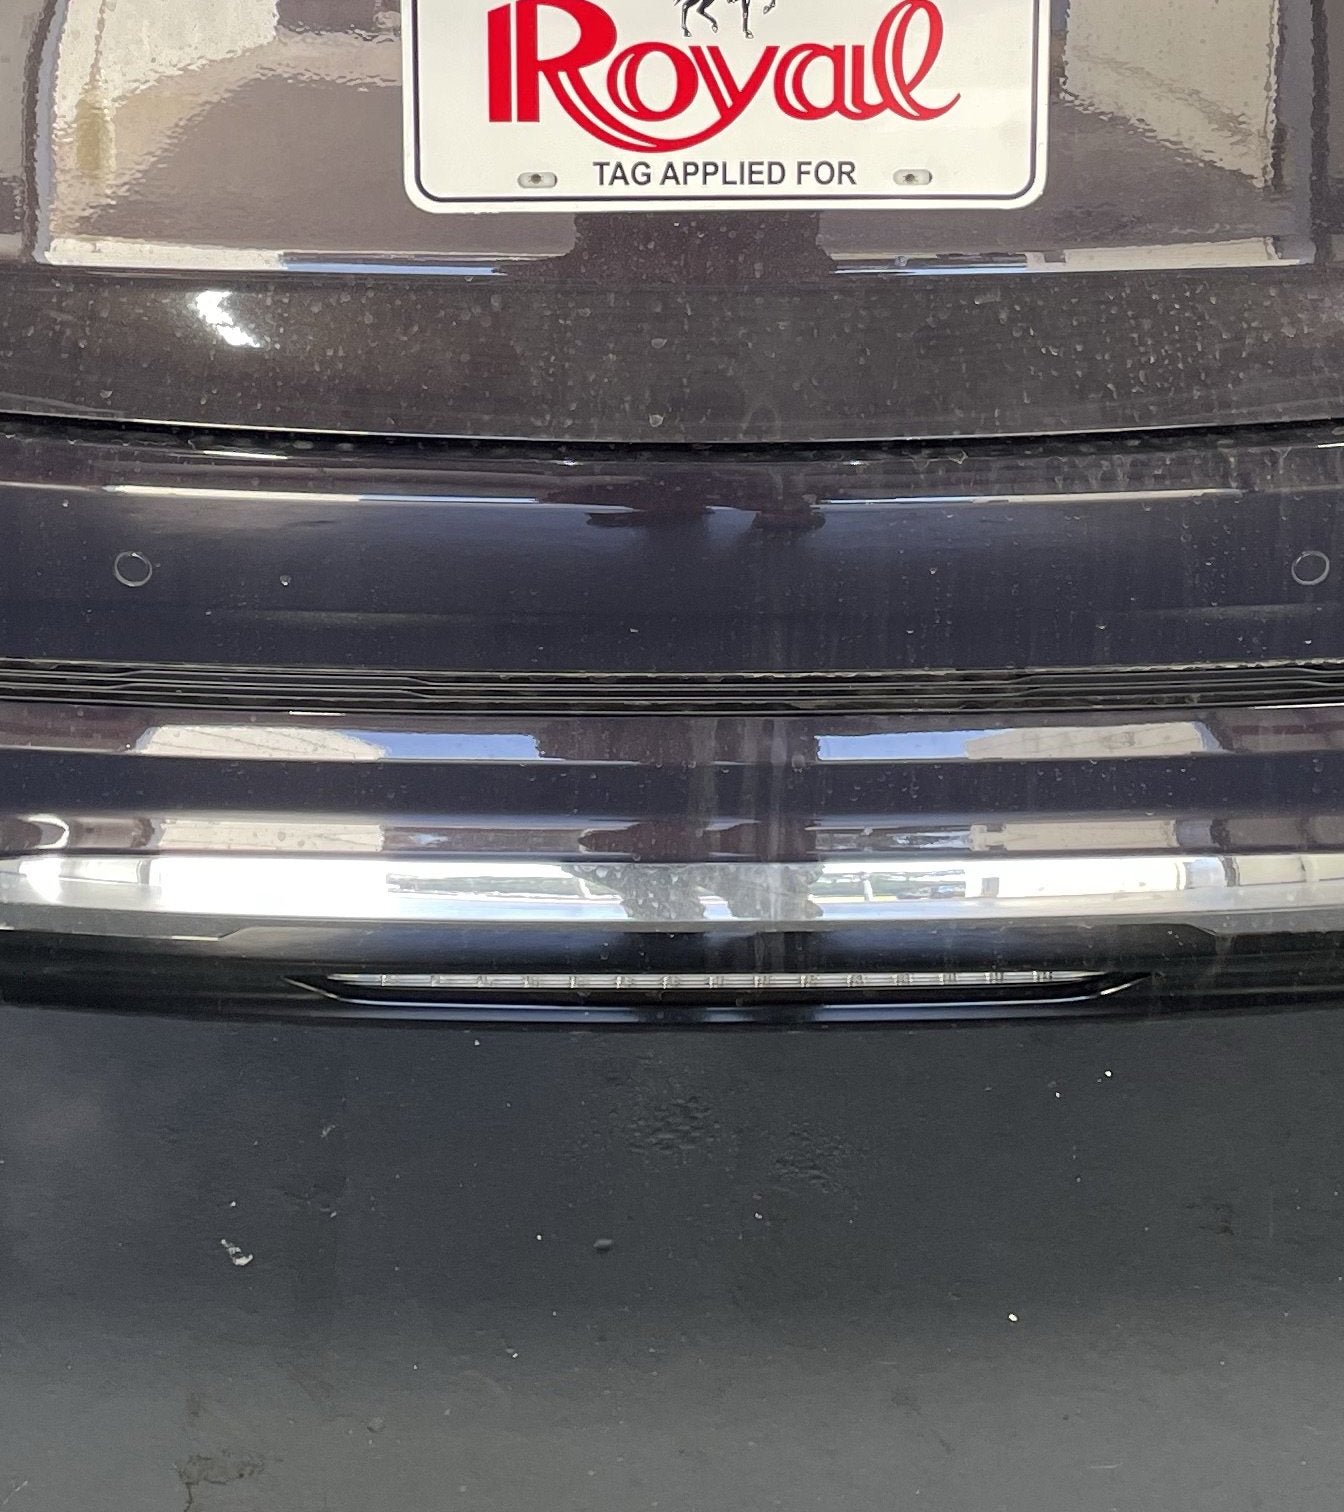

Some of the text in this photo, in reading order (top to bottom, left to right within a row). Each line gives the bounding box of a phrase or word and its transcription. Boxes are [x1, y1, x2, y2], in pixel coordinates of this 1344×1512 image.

[593, 160, 857, 187] TAG APPLIED FOR
